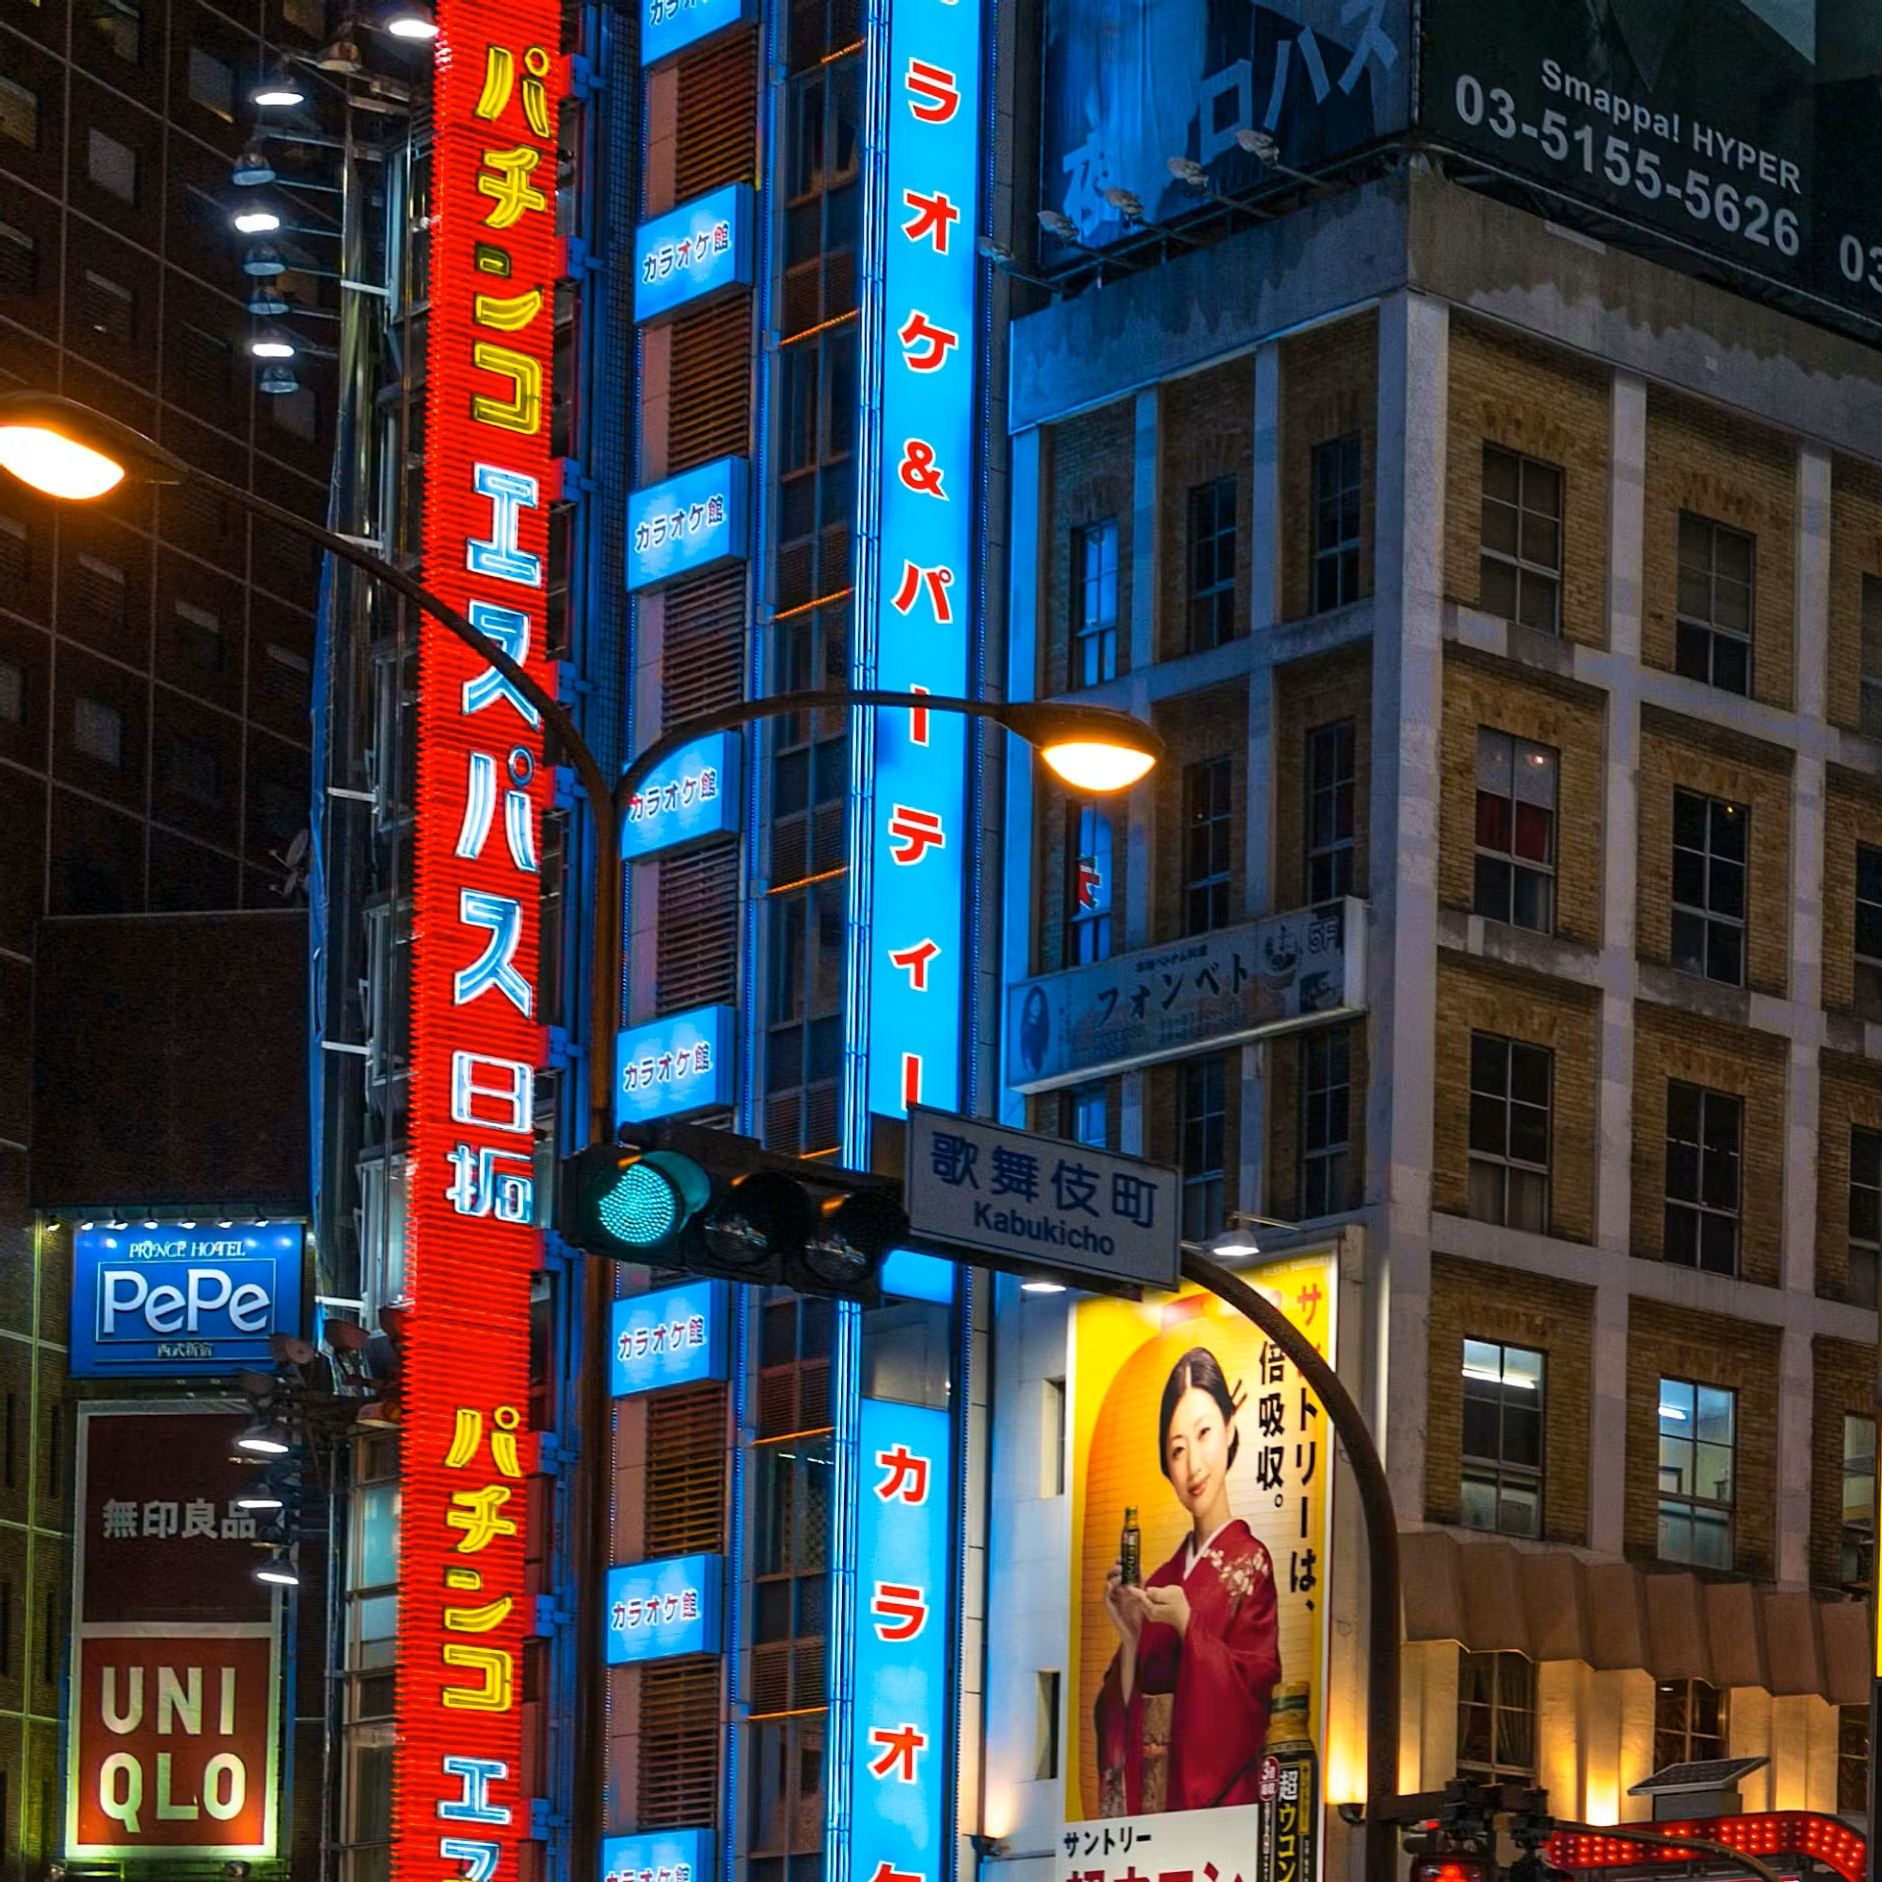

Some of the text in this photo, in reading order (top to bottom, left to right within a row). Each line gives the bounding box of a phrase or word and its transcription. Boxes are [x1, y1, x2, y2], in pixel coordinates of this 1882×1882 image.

[1540, 57, 1803, 194] Smappa! HYPER
[1454, 74, 1801, 258] 03-5155-5626
[642, 222, 731, 286] カラオケ館
[634, 494, 725, 553] カラオケ館
[629, 768, 719, 823] カラオケ館
[1095, 952, 1249, 1025] フォンベト
[930, 1130, 1160, 1230] 歌舞伎町
[128, 1240, 247, 1259] PRINCE HOTEL
[972, 1201, 1116, 1257] Kabukicho
[103, 1269, 271, 1335] PePe
[103, 1499, 257, 1540] 無印良品
[103, 1666, 238, 1736] UNI
[101, 1752, 247, 1834] QLO
[1064, 1827, 1152, 1859] サントリー
